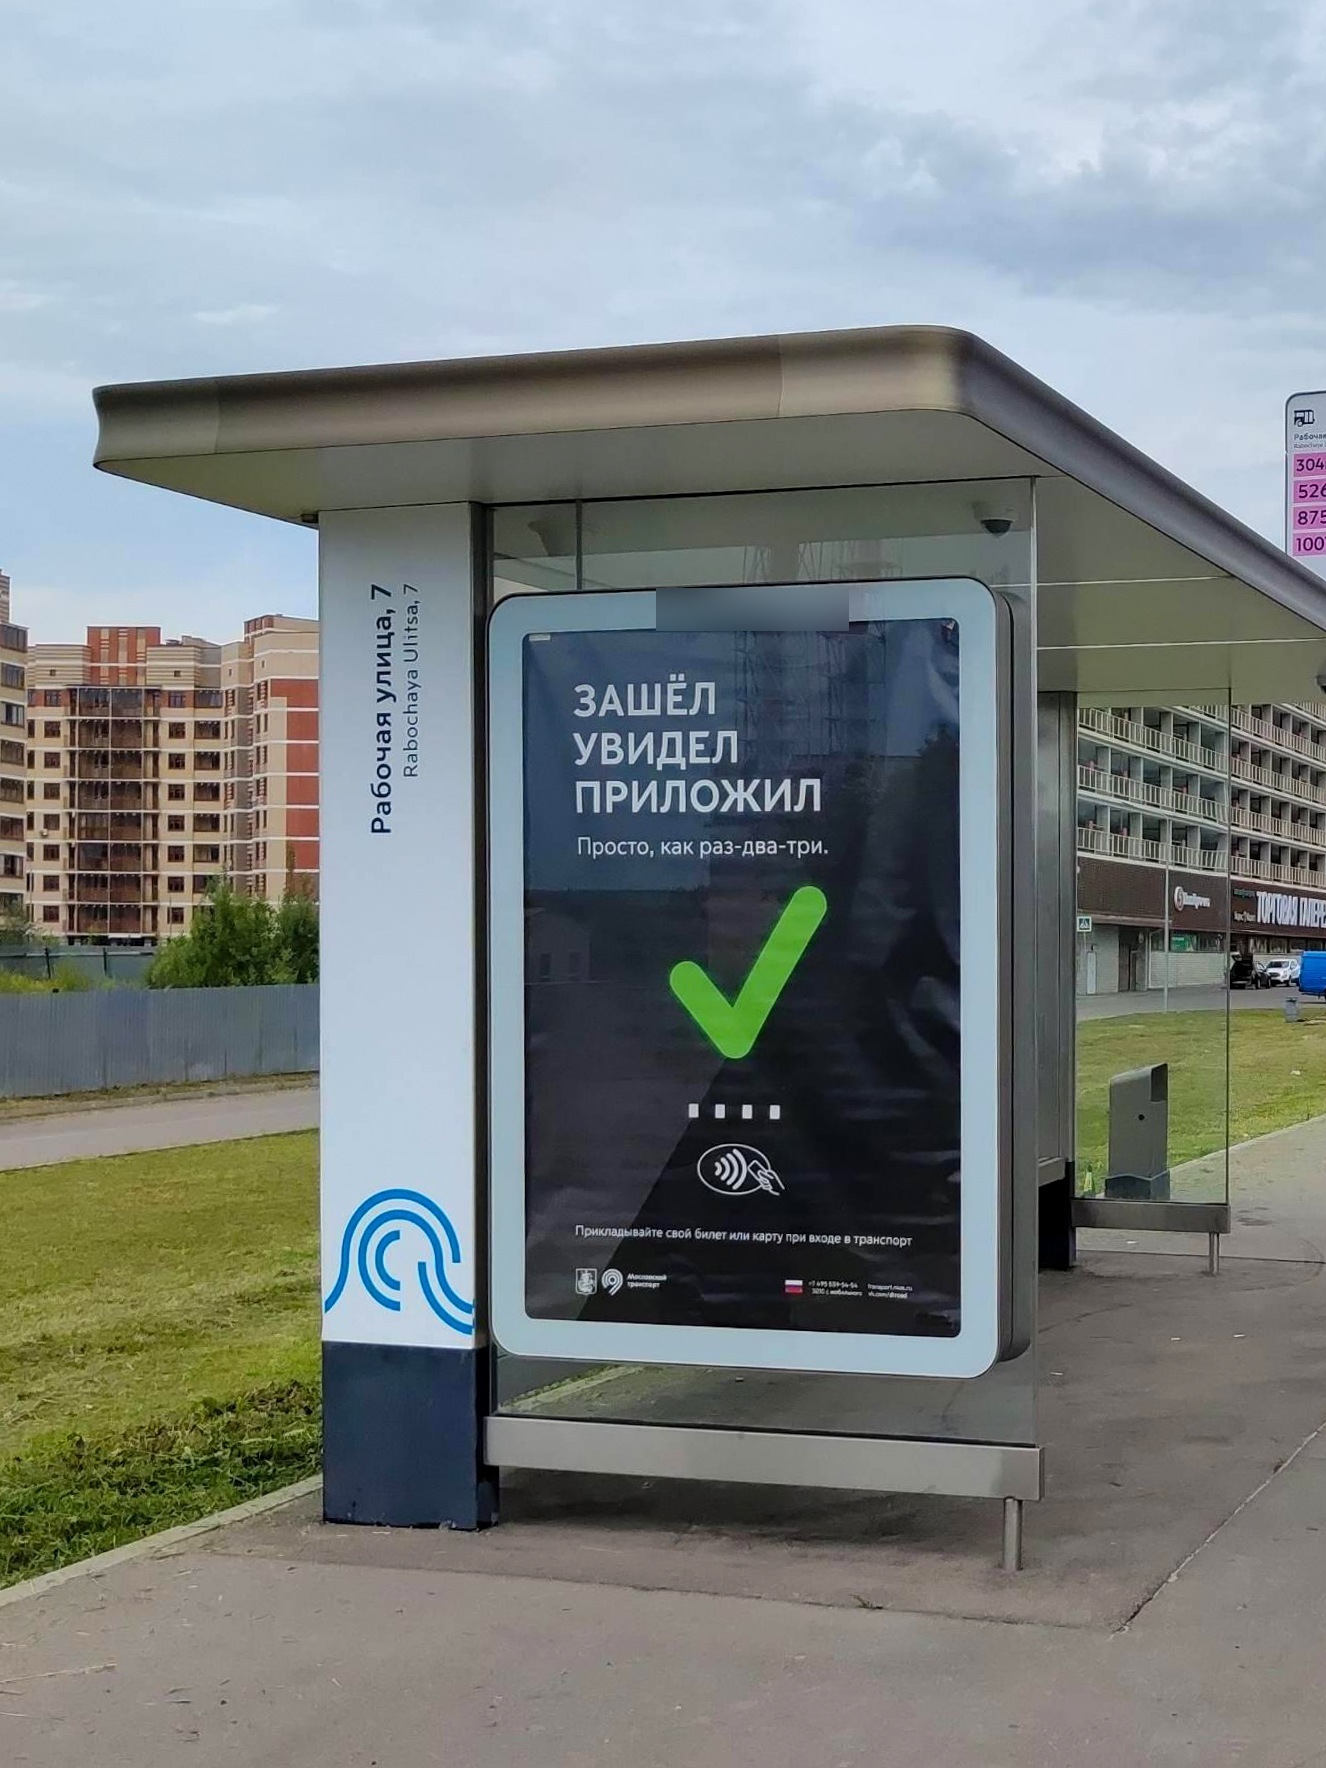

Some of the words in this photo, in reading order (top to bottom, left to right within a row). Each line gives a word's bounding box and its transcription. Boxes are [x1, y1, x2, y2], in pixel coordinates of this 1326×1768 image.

[371, 584, 392, 600] 7
[403, 583, 418, 593] 7
[403, 600, 421, 662] Ulitsa,
[376, 608, 396, 704] улица,
[573, 673, 716, 718] ЗАШЁЛ
[403, 669, 422, 777] Rabochaya
[572, 730, 739, 771] УВИДЕЛ
[370, 712, 392, 833] Рабочая
[574, 778, 822, 814] ПРИЛОЖИЛ
[577, 836, 655, 859] Просто,
[661, 841, 694, 855] как
[700, 839, 829, 859] раз-два-три.
[1256, 891, 1298, 926] ТОРГОВАЯ
[575, 1224, 663, 1238] Прикладывайте
[666, 1228, 691, 1238] свой
[694, 1228, 726, 1240] билет
[729, 1232, 750, 1241] или
[753, 1232, 783, 1244] карту
[786, 1233, 806, 1244] при
[808, 1234, 841, 1244] входе
[844, 1236, 851, 1244] в
[853, 1235, 913, 1248] транспорт
